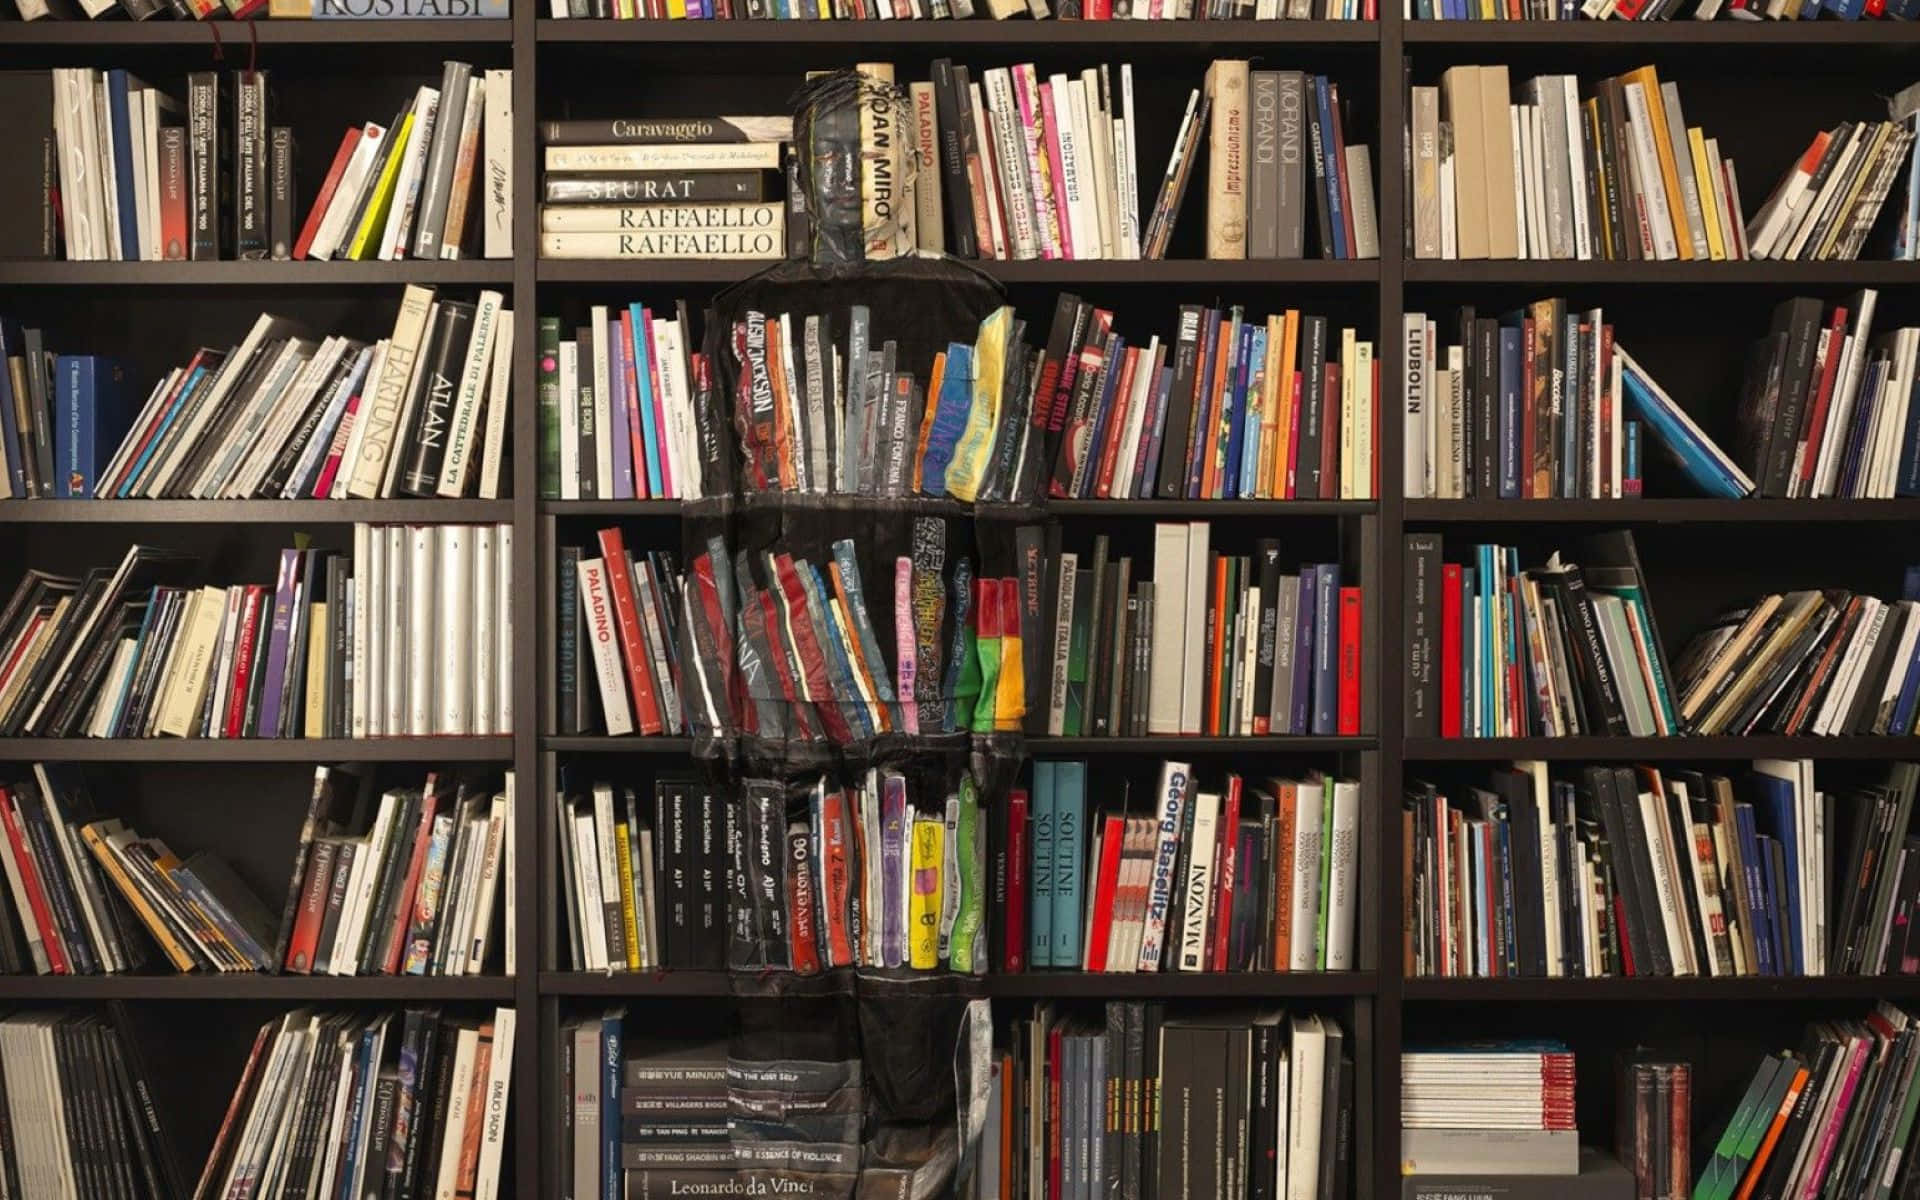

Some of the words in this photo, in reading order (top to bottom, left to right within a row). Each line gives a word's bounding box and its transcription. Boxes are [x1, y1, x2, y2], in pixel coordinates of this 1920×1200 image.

[612, 119, 713, 141] Caravaggio
[918, 91, 934, 168] PALADINO
[1224, 108, 1242, 195] Impressionismo
[1256, 79, 1275, 164] MORANDI
[1281, 79, 1299, 164] MORANDI
[1421, 131, 1434, 159] Berti
[588, 179, 695, 200] SEURAT
[619, 208, 774, 228] RAFFAELLO
[618, 234, 774, 254] RAFFAELLO
[475, 302, 494, 362] PALERMO
[470, 364, 479, 380] DI
[747, 346, 773, 412] JACKSON
[1407, 328, 1422, 414] LIUBOLIN
[1451, 369, 1462, 420] ANTONIO
[1551, 368, 1565, 417] Boccioni
[361, 344, 414, 464] HARTUNG
[421, 372, 453, 448] ATLAN
[451, 383, 477, 465] CATTEDRALE
[891, 400, 906, 439] FRANCO
[1451, 423, 1462, 464] BUENO
[446, 469, 458, 485] LA
[561, 558, 575, 622] IMAGES
[585, 567, 611, 643] PALADINO
[1058, 559, 1074, 624] PADIGLIONE
[1055, 624, 1068, 661] ITALIA
[1576, 599, 1593, 629] TONO
[1585, 627, 1611, 683] ZANCANARO
[674, 795, 682, 818] Mario
[703, 795, 712, 818] Mario
[727, 803, 735, 818] ario
[1159, 771, 1187, 834] Georg
[674, 818, 682, 854] Schifano
[703, 818, 712, 854] Schifano
[1032, 813, 1053, 896] SOUTINE
[1058, 811, 1073, 896] SOUTINE
[1150, 838, 1176, 921] Baselitz
[1184, 863, 1207, 948] MANZONI
[671, 1178, 744, 1196] Leonardo
[746, 1176, 767, 1196] da
[770, 1178, 814, 1194] Vinci
